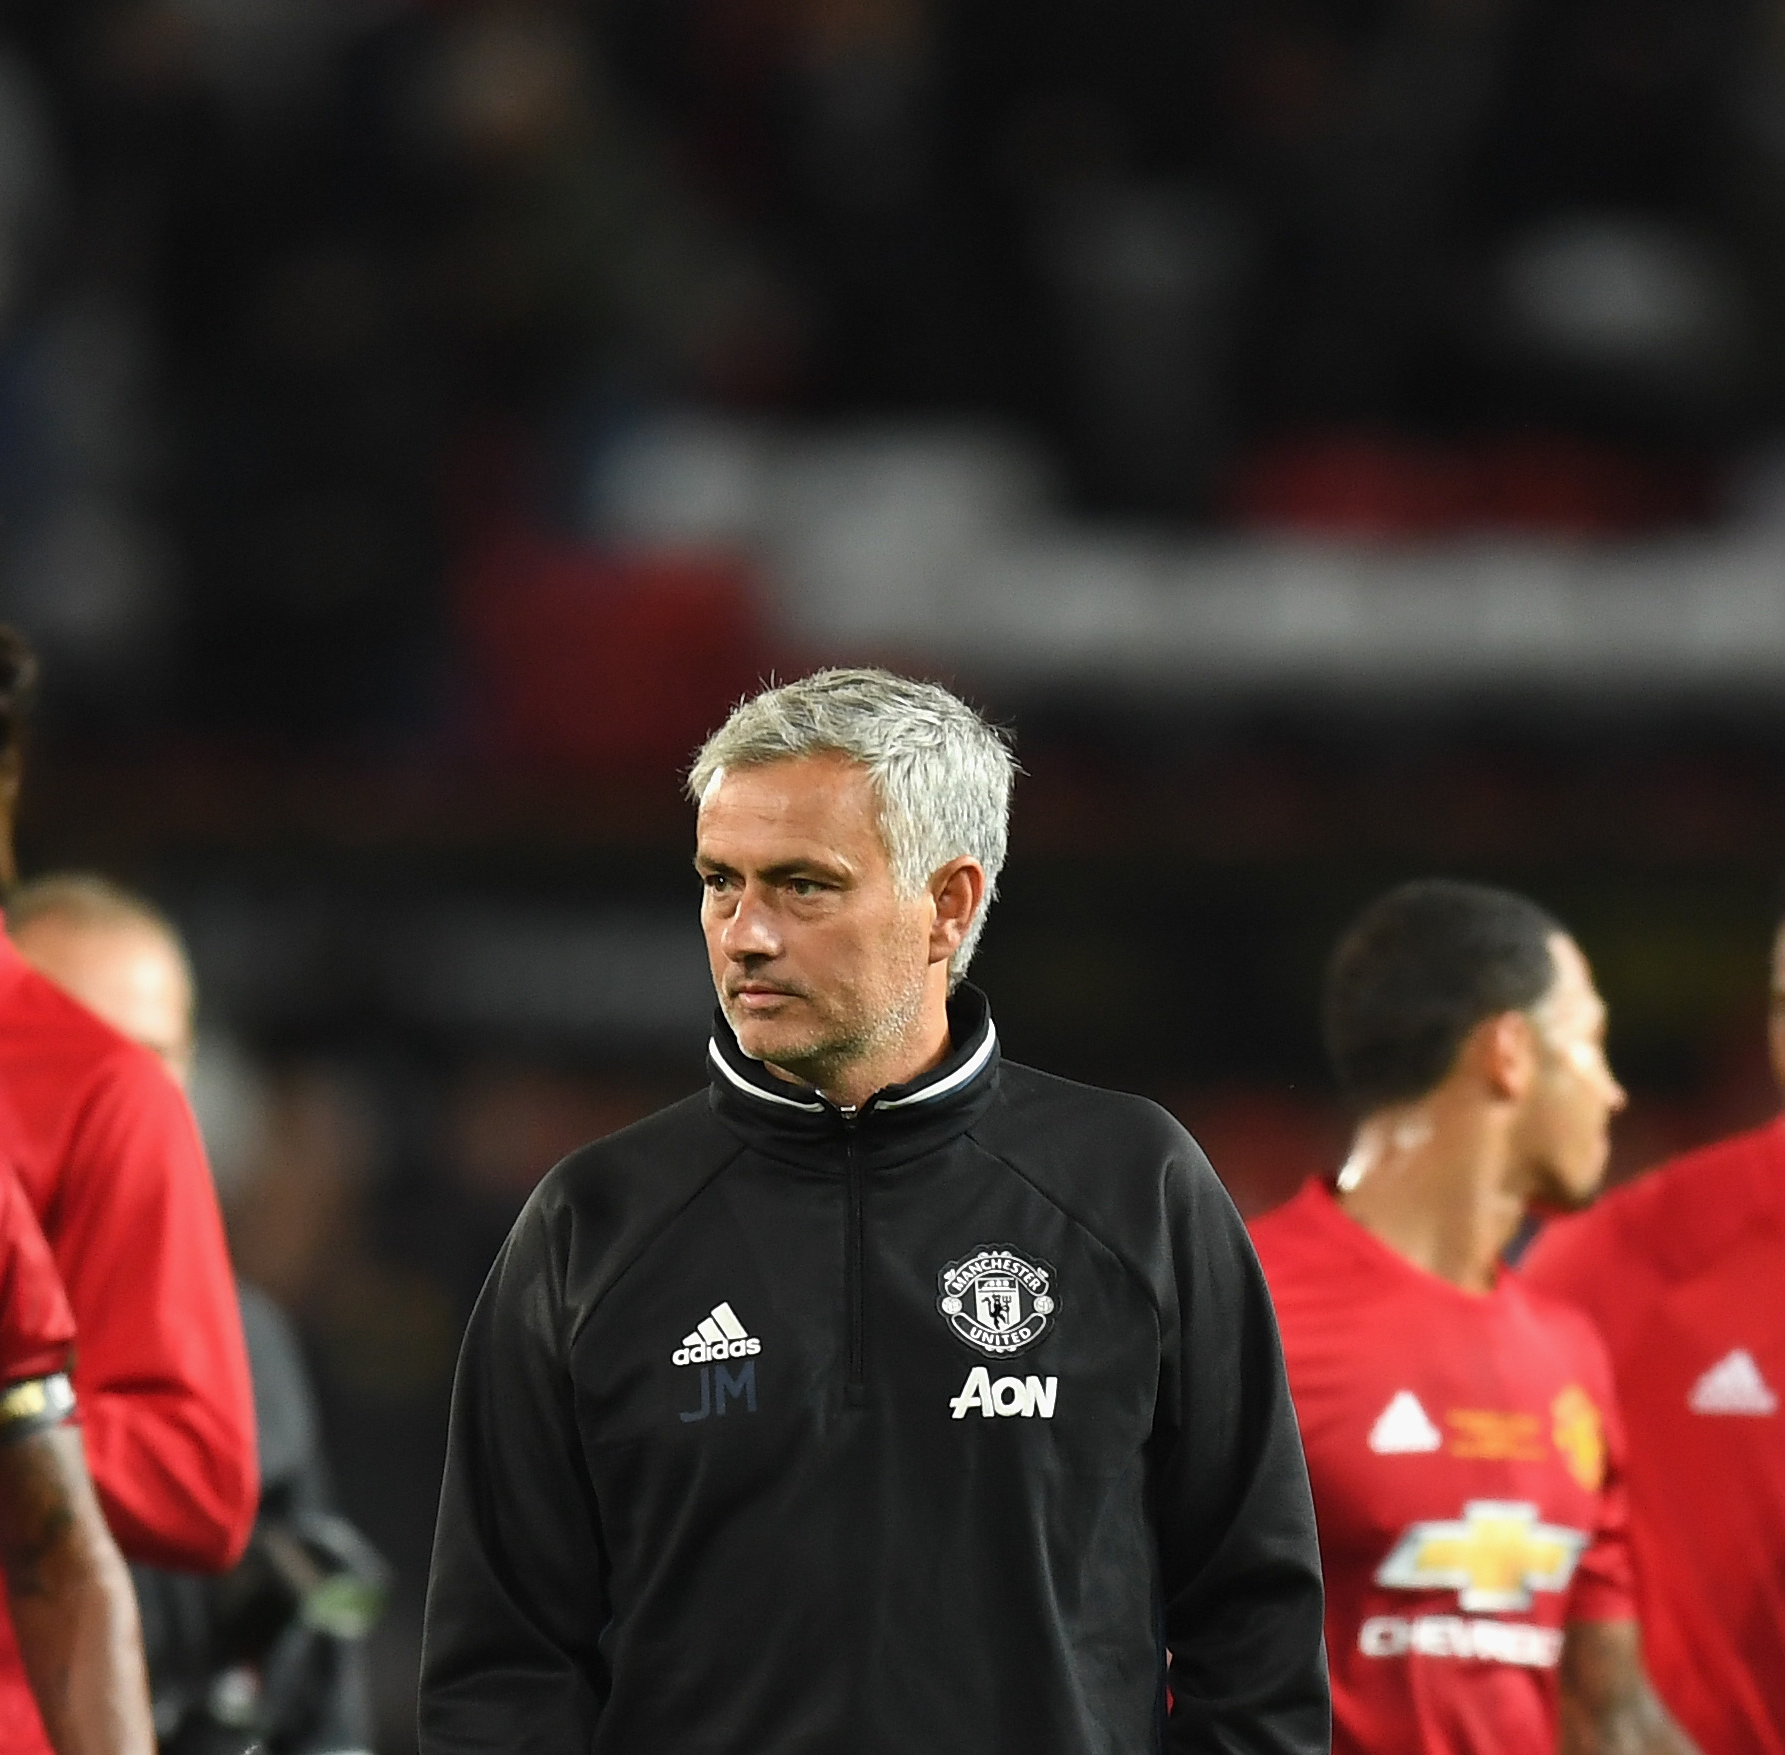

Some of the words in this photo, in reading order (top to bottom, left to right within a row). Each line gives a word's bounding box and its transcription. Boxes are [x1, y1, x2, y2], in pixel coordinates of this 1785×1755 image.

[951, 1258, 1042, 1292] MANCHESTER
[671, 1336, 762, 1366] adidas
[969, 1326, 1032, 1346] UNITED
[679, 1359, 758, 1423] JM
